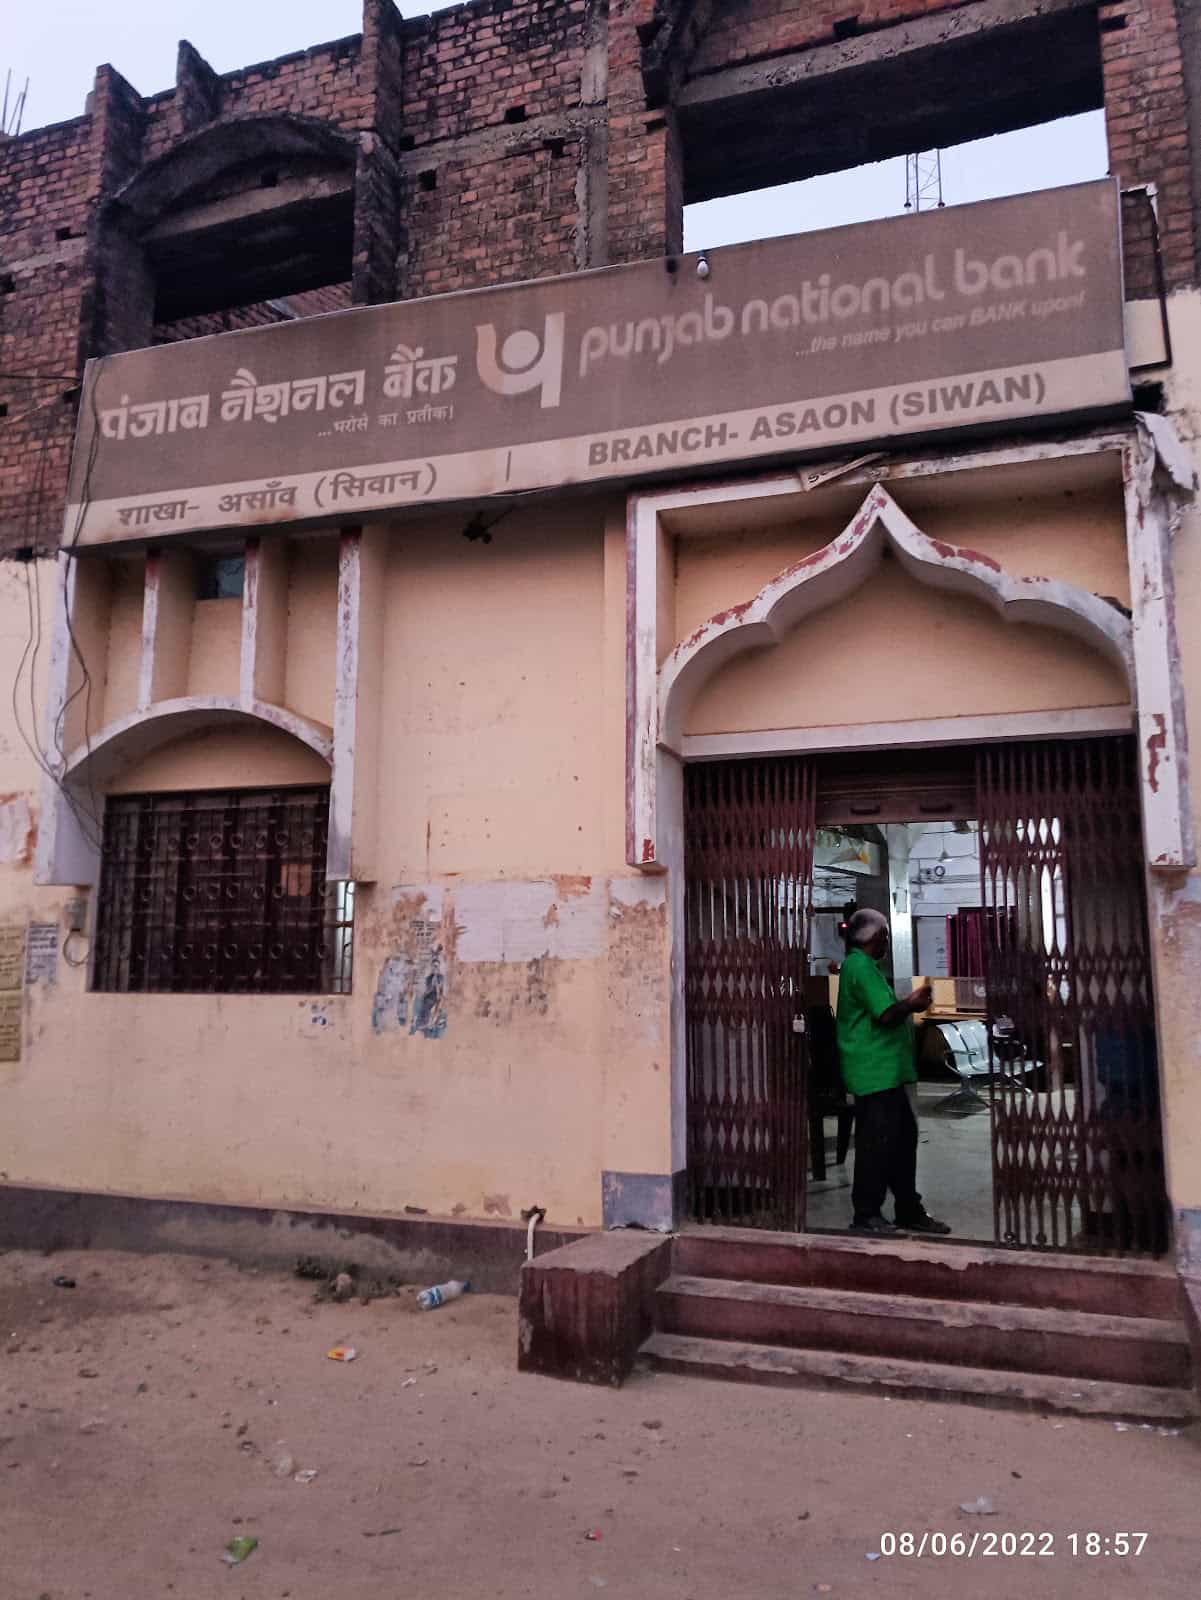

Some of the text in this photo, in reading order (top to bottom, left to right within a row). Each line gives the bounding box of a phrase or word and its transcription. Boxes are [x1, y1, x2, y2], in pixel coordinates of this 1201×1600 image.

[580, 230, 1085, 376] punjab national bank
[841, 327, 891, 349] name
[894, 319, 927, 342] you
[931, 316, 965, 332] can
[968, 302, 1025, 327] BANK
[102, 343, 458, 440] पंजाब नैशनल बैंक
[378, 412, 398, 427] का
[588, 371, 1047, 466] BRANCH- ASAON (SIWAN)
[313, 462, 438, 508] (सिवान)
